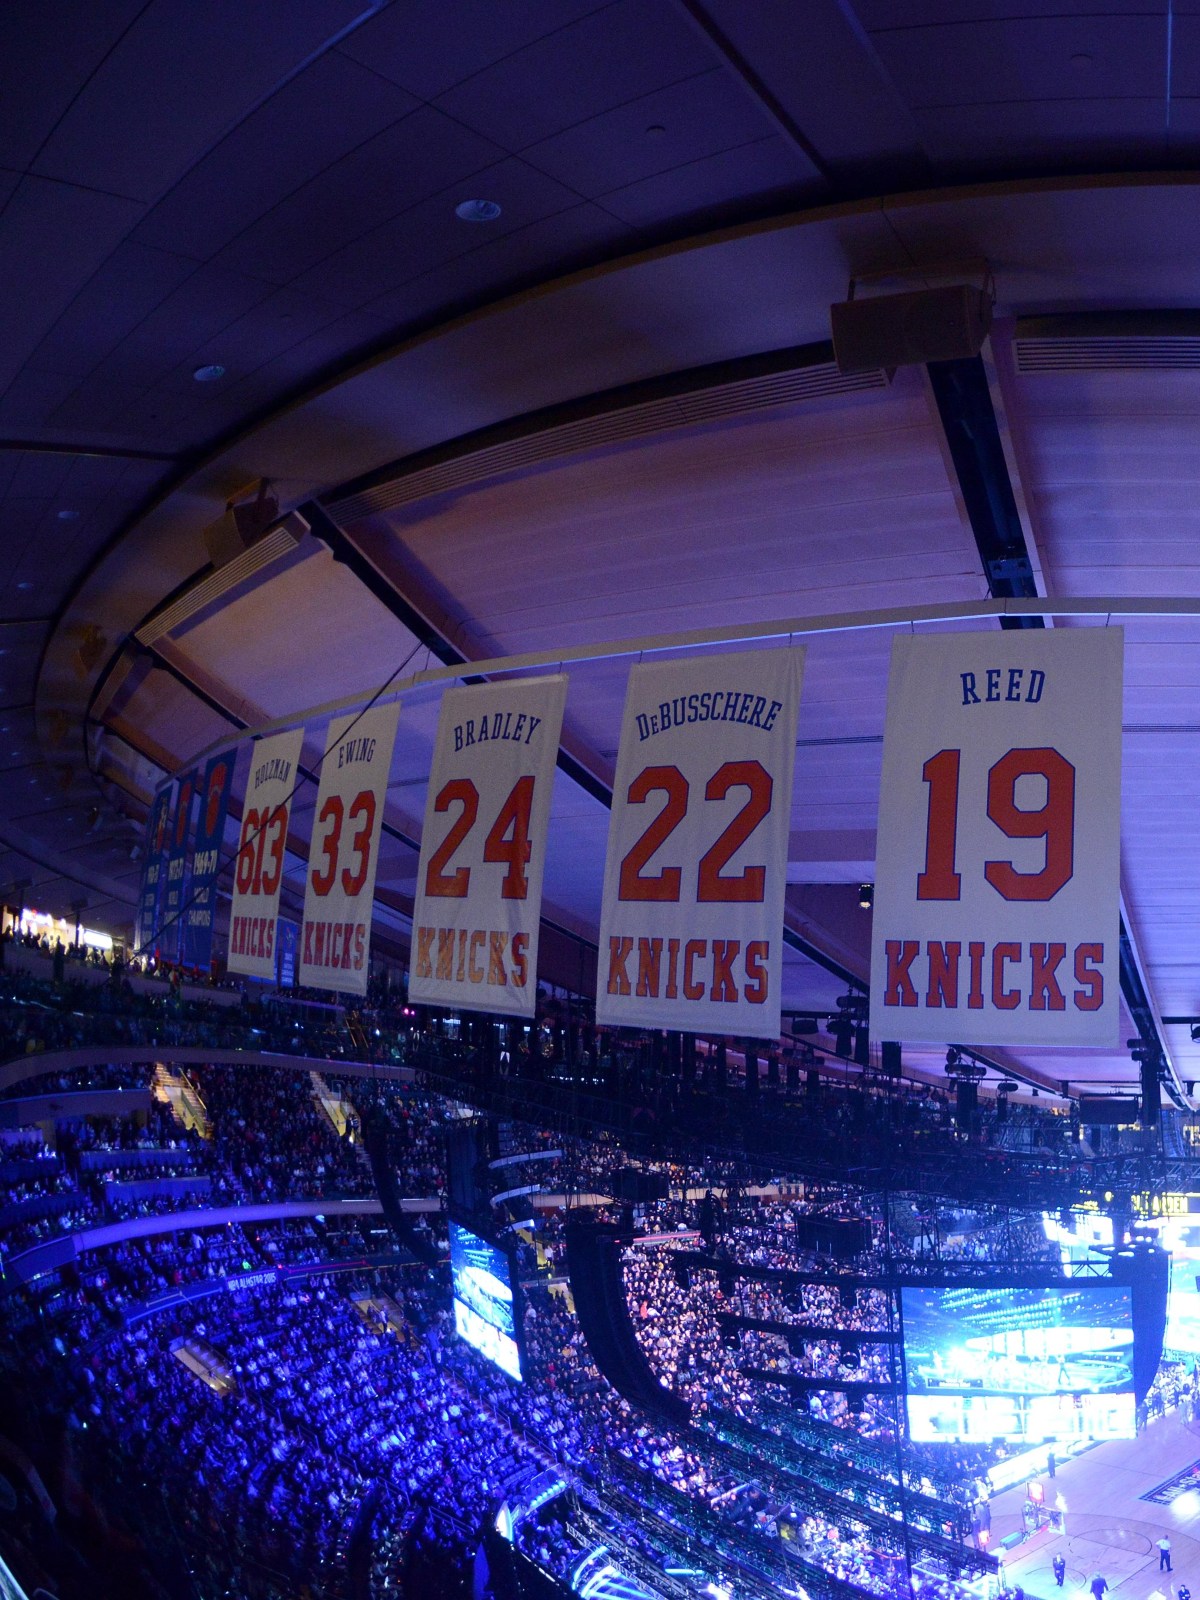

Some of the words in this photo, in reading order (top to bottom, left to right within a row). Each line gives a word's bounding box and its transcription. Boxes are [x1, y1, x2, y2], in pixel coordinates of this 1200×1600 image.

[635, 691, 783, 742] DeBUSSCHERE
[960, 669, 1046, 705] REED
[338, 738, 377, 769] EWING
[453, 712, 542, 753] BRADLEY
[254, 758, 292, 790] HOLZMAN
[236, 803, 289, 896] 613
[311, 789, 377, 897] 33
[425, 775, 536, 900] 24
[618, 760, 773, 903] 22
[916, 747, 1077, 902] 19
[231, 916, 275, 959] KNICKS
[303, 921, 366, 972] KNICKS
[415, 926, 530, 988] KNICKS
[607, 935, 770, 1004] KNICKS
[884, 940, 1104, 1011] KNICKS
